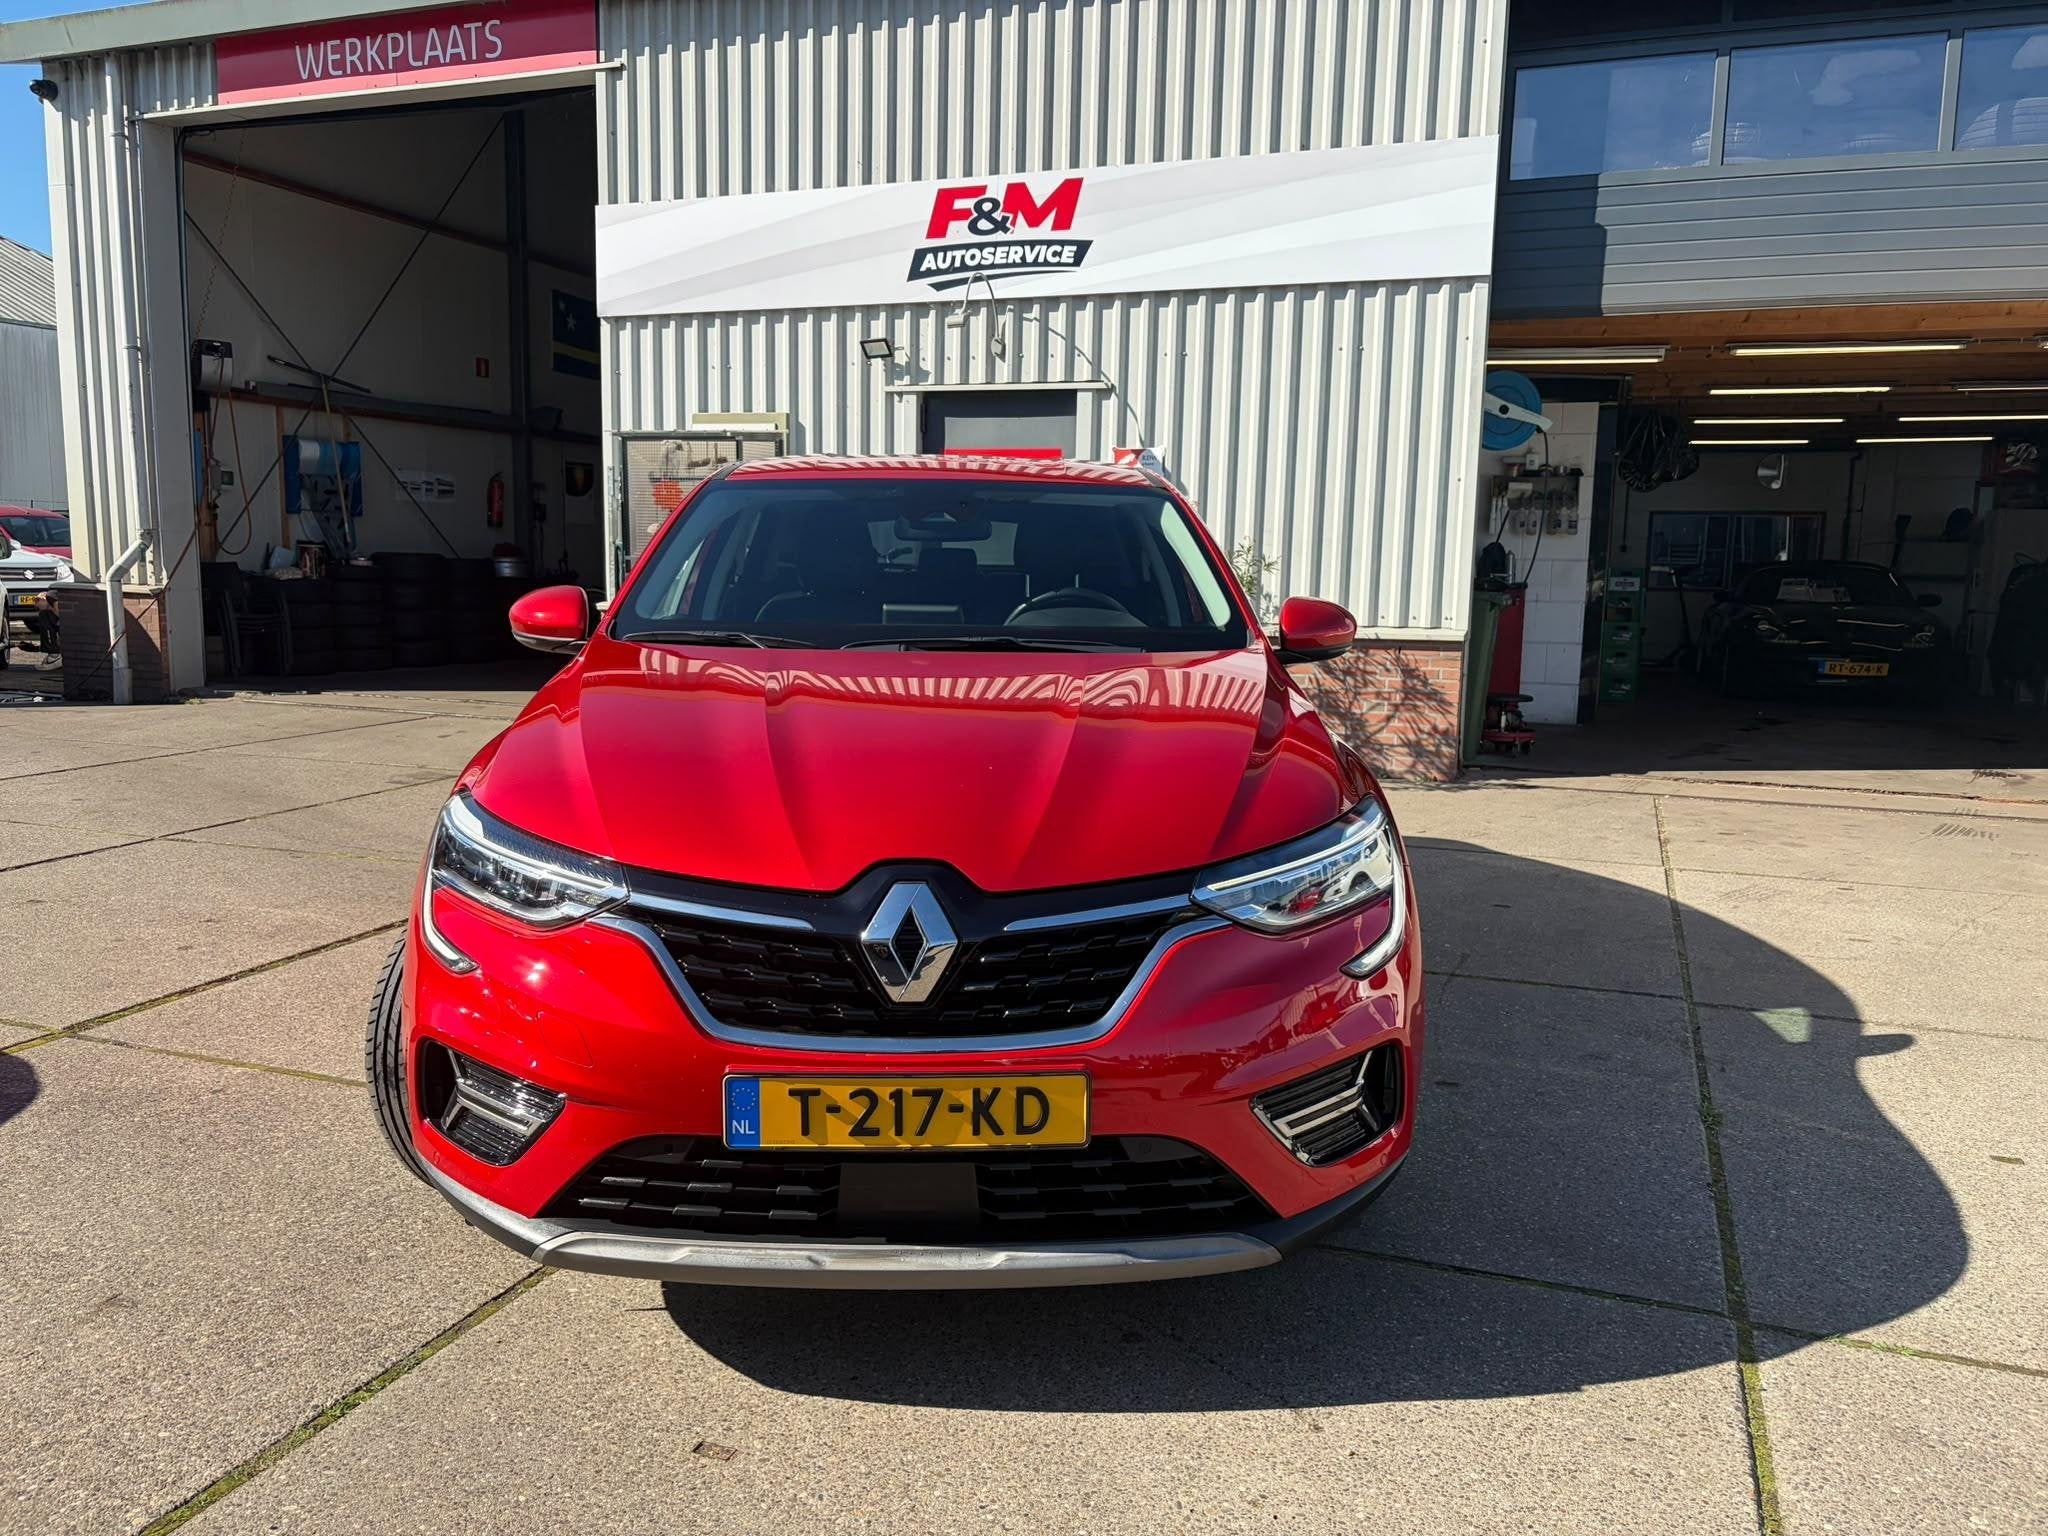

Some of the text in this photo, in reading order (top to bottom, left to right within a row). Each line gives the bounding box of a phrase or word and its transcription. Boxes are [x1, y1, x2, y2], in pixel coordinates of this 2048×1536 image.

[295, 19, 503, 80] WERKPLAATS
[925, 177, 1084, 239] F&M
[919, 244, 1078, 273] AUTOSERVICE
[732, 1086, 1050, 1137] NL T-217-KD
